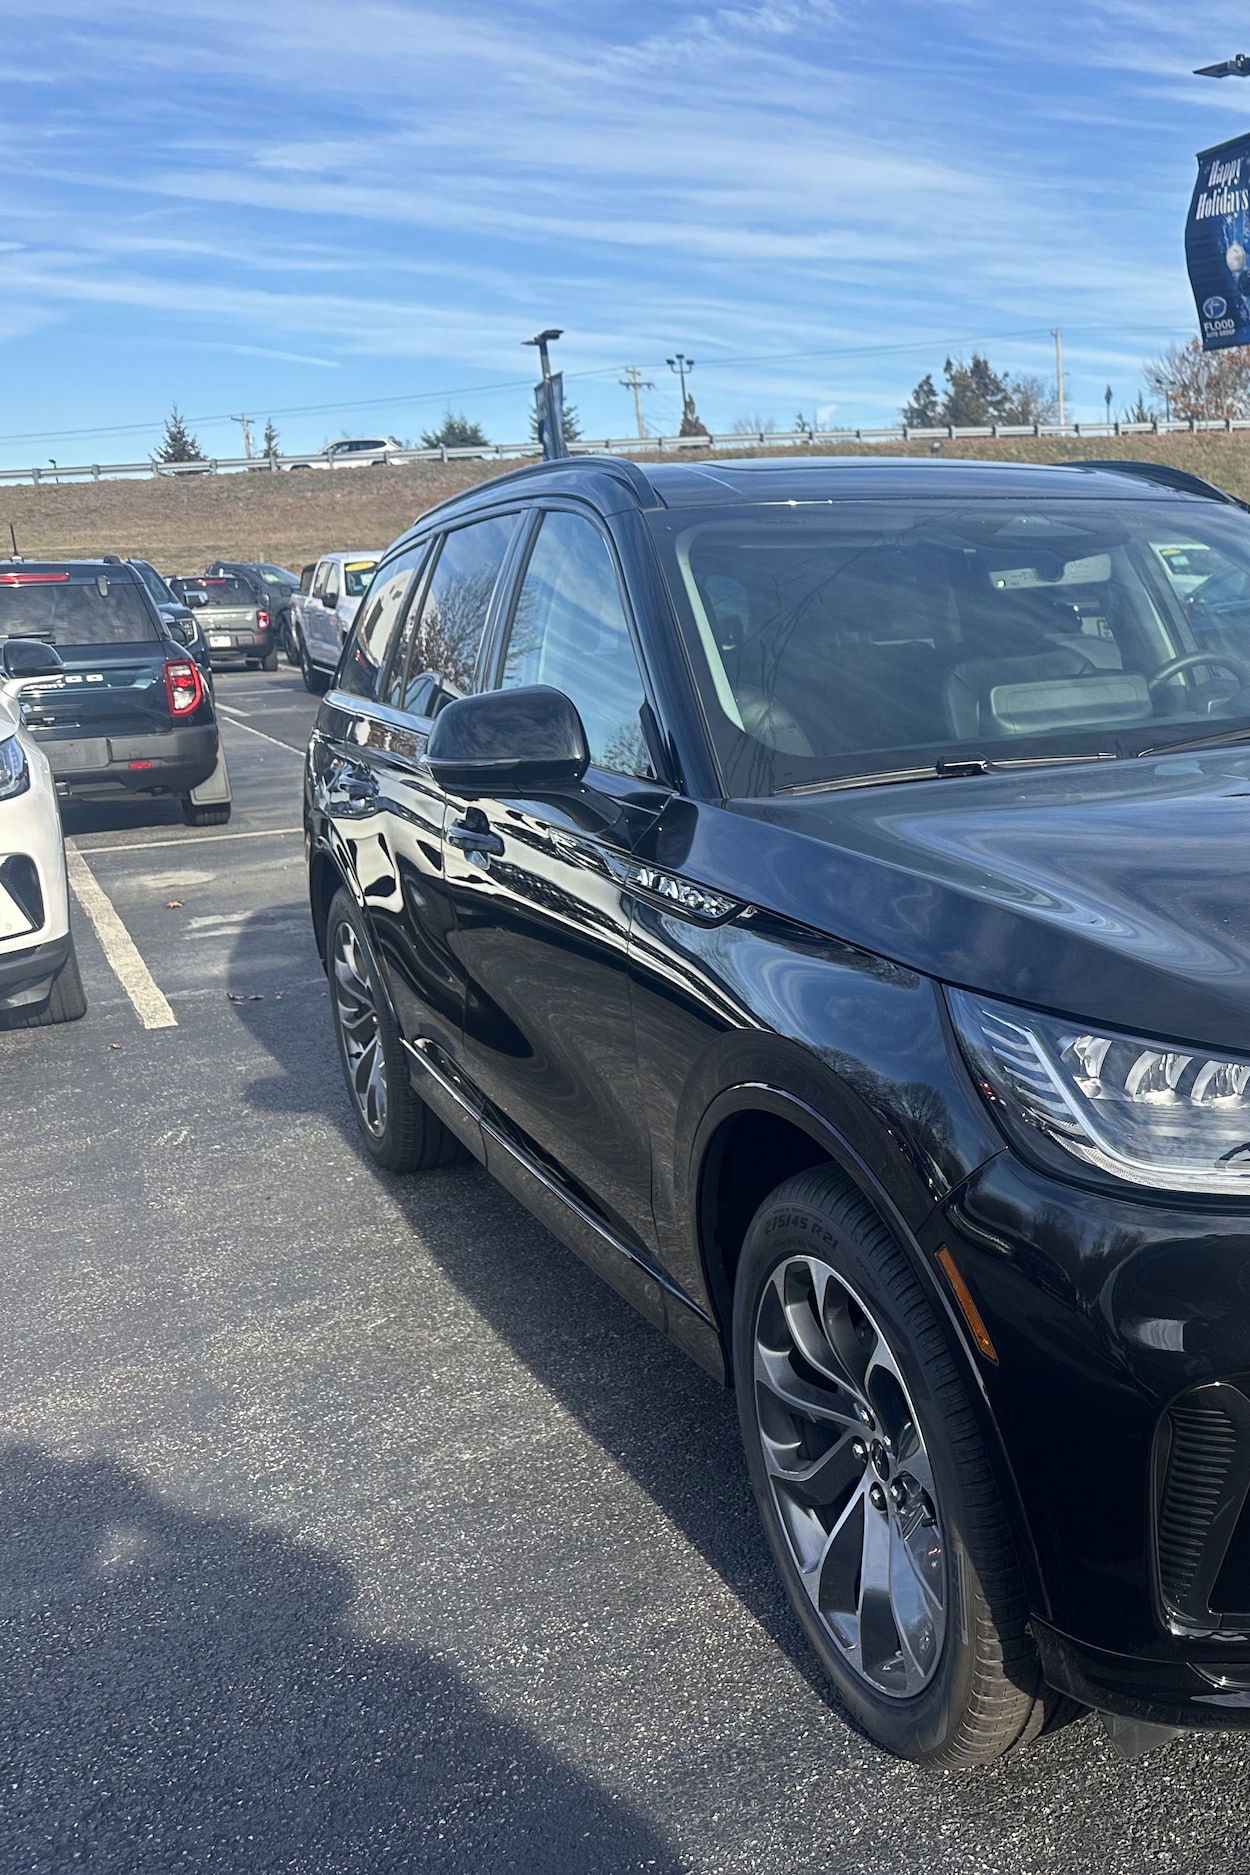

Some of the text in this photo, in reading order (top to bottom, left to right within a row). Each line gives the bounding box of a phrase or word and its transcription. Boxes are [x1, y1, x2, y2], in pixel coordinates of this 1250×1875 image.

[1208, 157, 1245, 189] Happy
[1196, 189, 1249, 220] Holidays
[1203, 319, 1235, 333] FLOOD
[764, 1214, 809, 1236] 275/45
